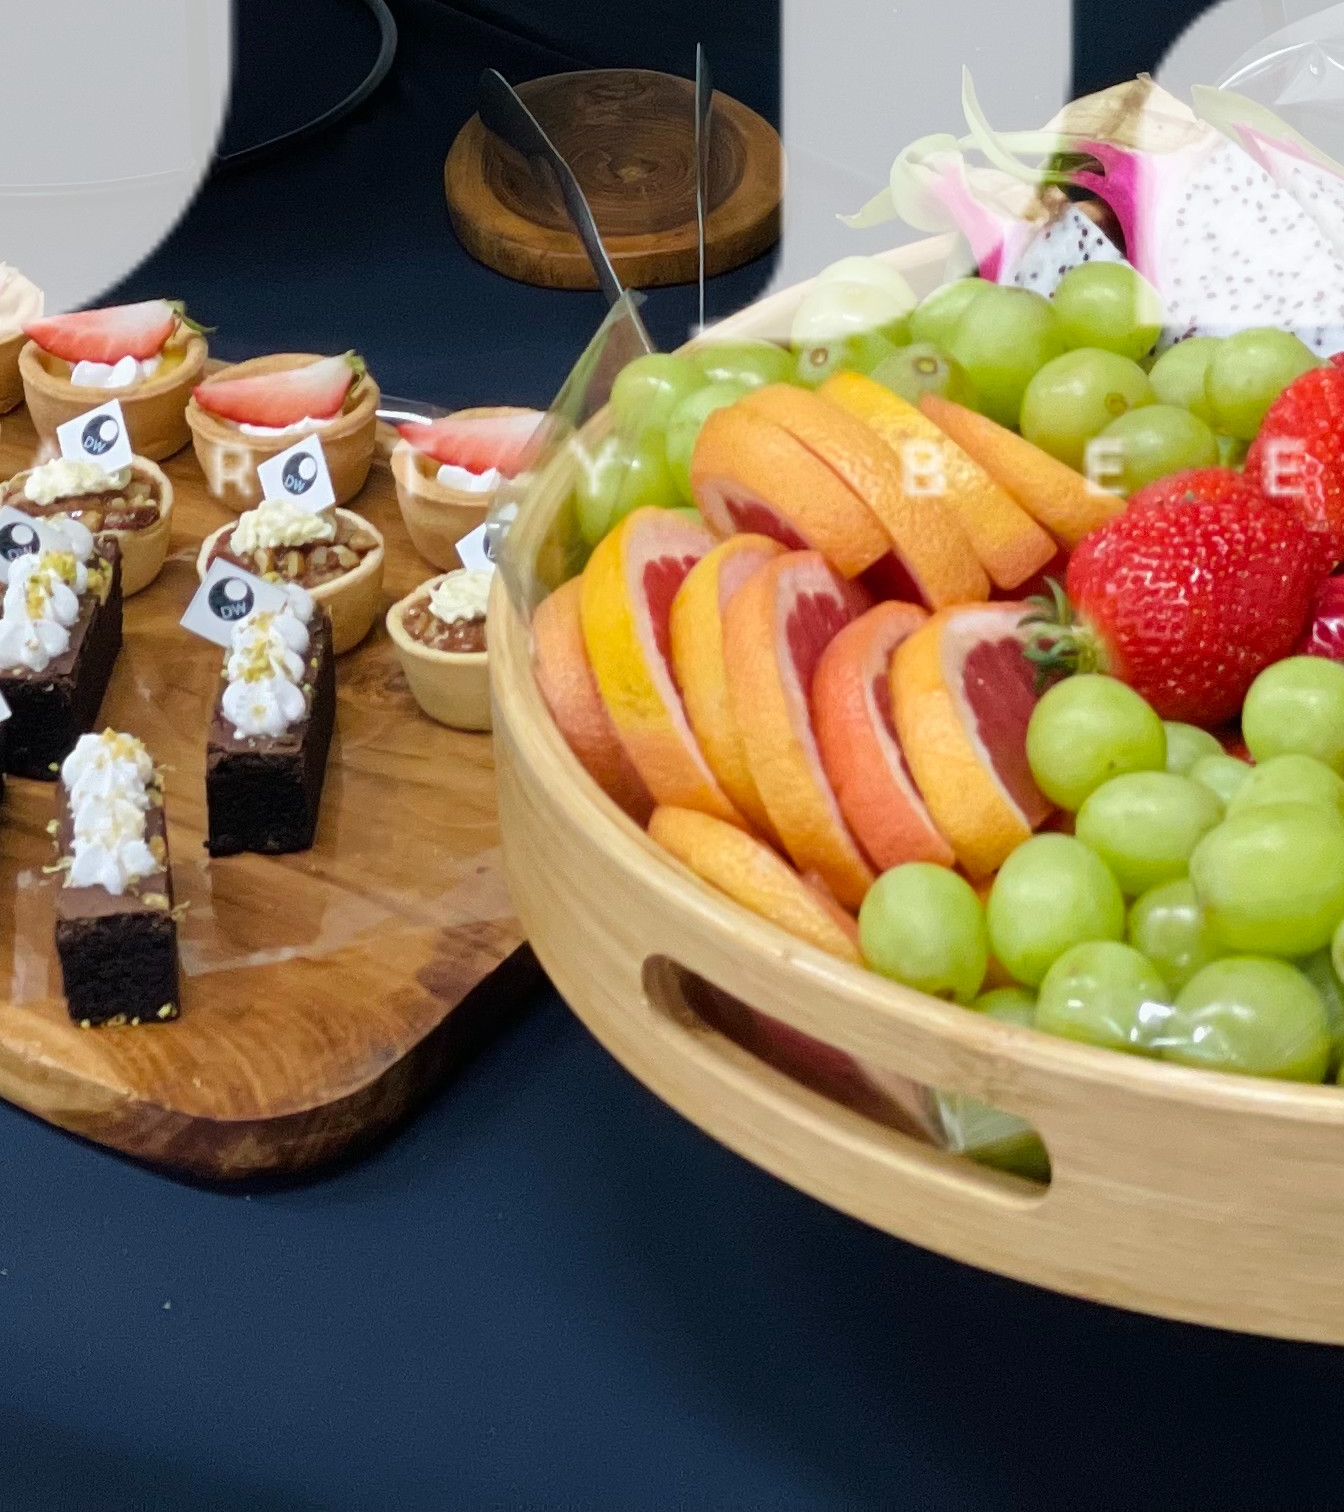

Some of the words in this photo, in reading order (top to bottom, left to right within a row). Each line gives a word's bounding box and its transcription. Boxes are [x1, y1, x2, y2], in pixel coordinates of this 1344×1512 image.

[83, 435, 106, 452] DW
[284, 474, 305, 492] DW
[220, 601, 246, 619] DW
